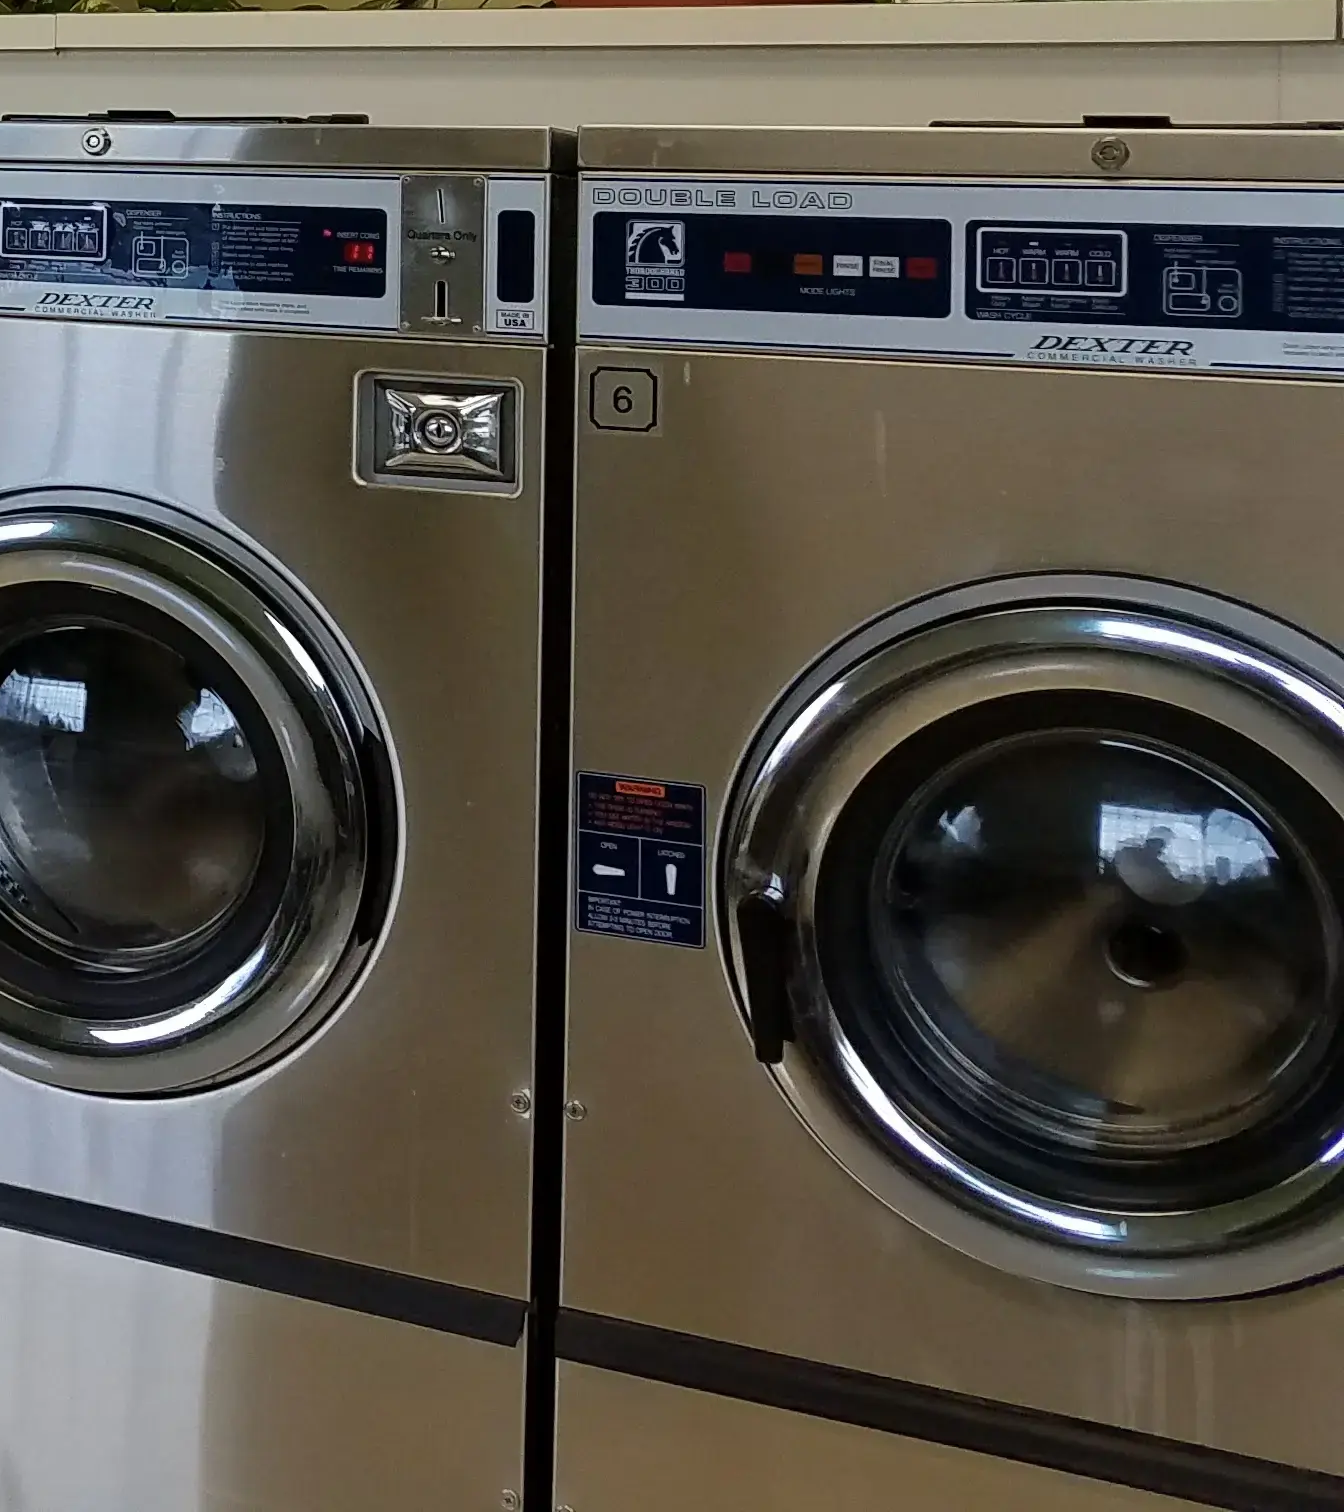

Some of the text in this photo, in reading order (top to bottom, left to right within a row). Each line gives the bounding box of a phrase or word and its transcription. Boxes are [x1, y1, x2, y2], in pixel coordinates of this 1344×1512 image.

[592, 188, 853, 210] DOUBLE LOAD
[454, 230, 477, 242] Only
[625, 276, 685, 291] 300
[37, 292, 155, 310] DEXTER
[34, 306, 157, 319] COMMERCIAL WASHER
[504, 318, 527, 328] USA
[1030, 335, 1195, 356] DEXTER
[1027, 351, 1197, 367] COMMERCIAL WASHER
[613, 385, 633, 413] 6
[600, 842, 618, 850] OPEN
